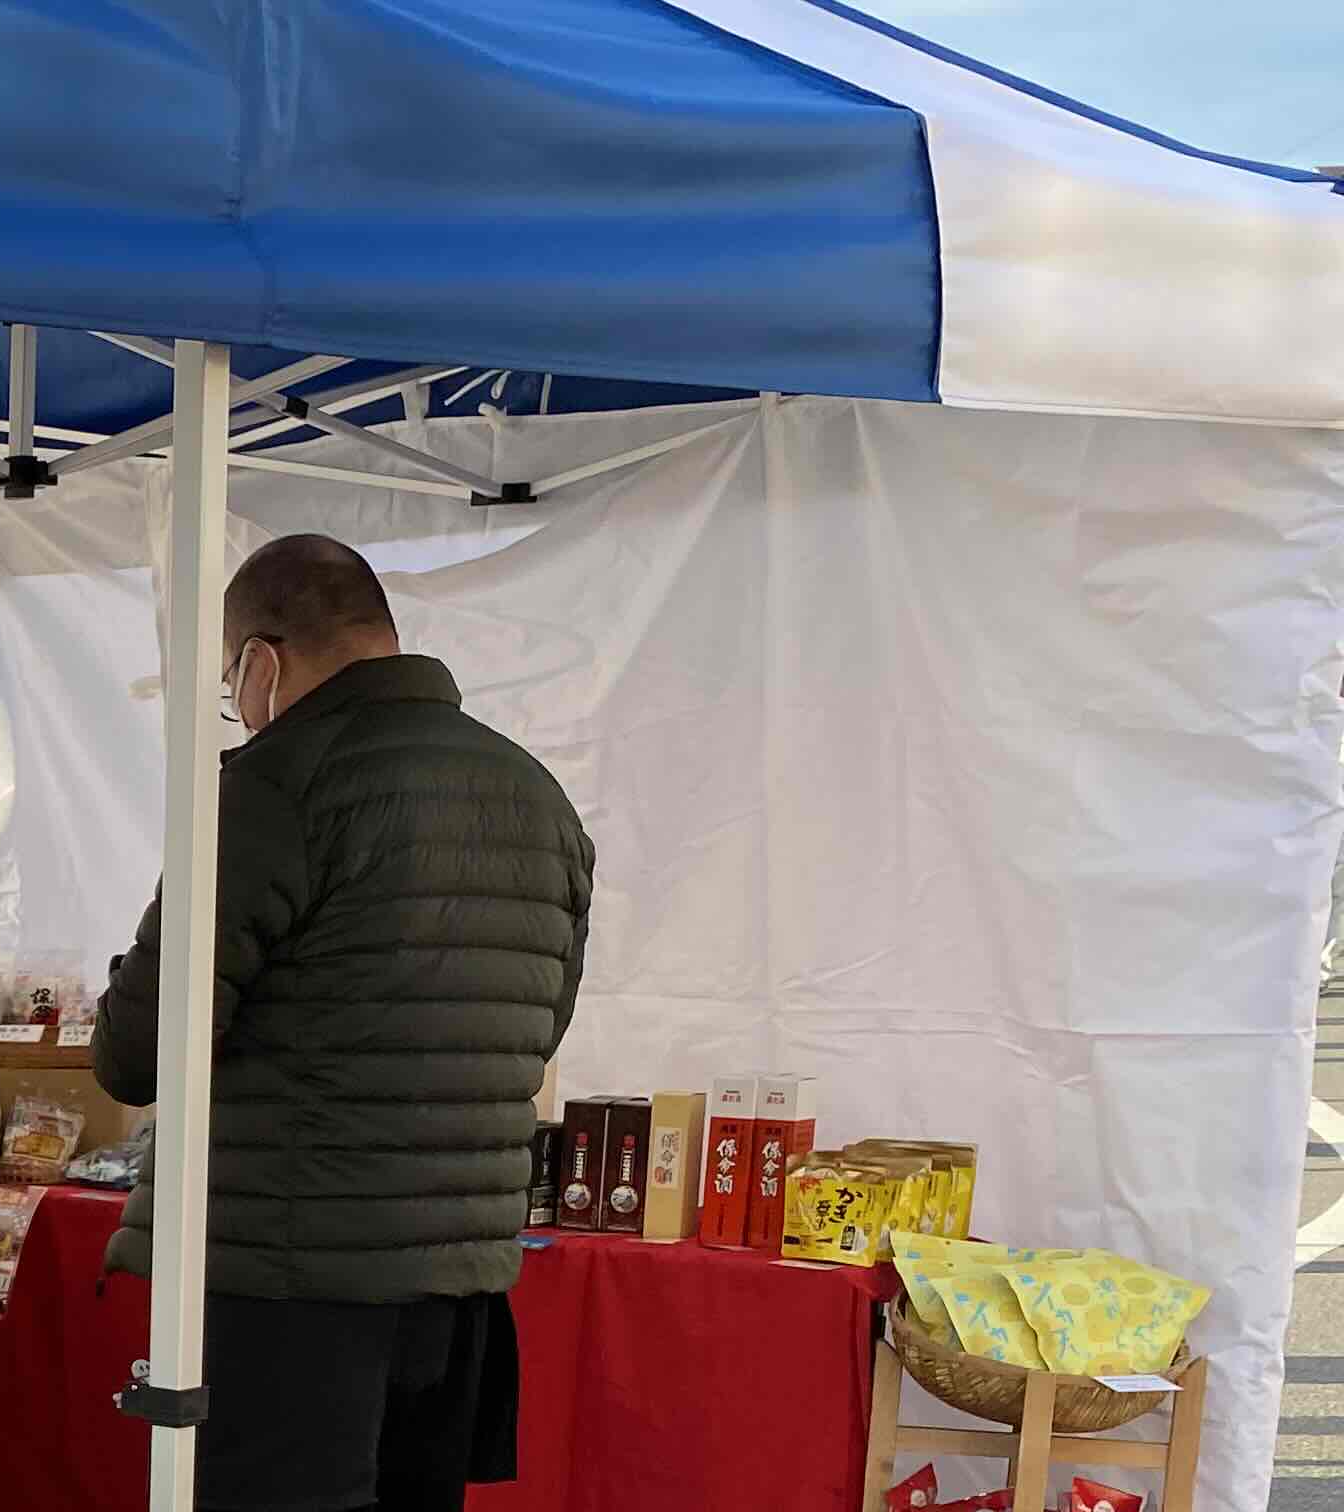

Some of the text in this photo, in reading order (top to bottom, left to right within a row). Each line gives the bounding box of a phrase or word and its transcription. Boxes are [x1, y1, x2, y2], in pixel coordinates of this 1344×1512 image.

[714, 1138, 737, 1195] 保命酒
[760, 1141, 782, 1198] 保命酒
